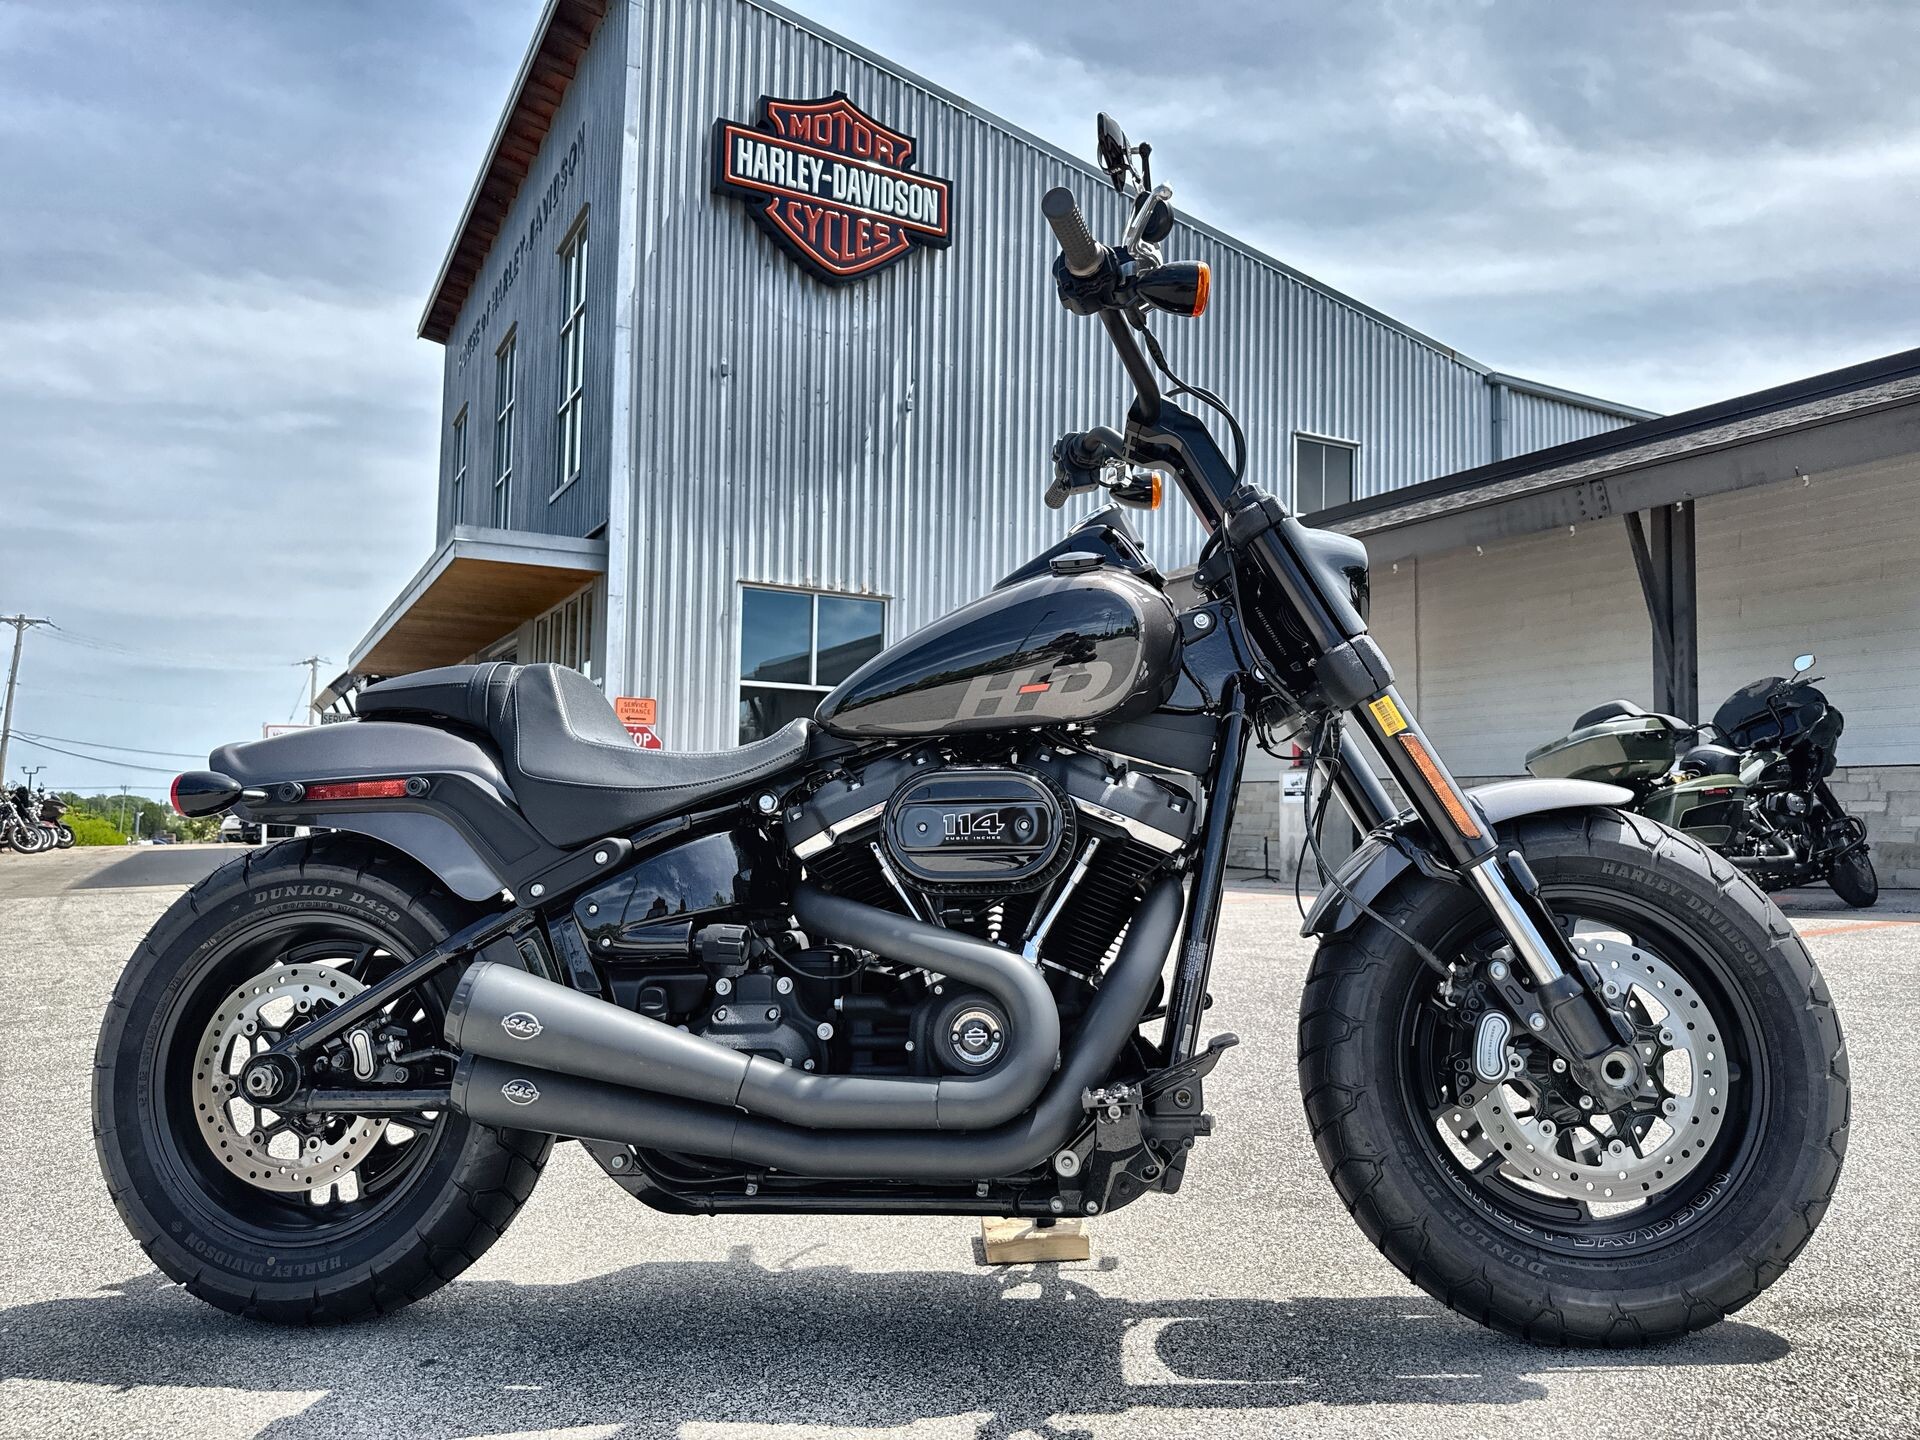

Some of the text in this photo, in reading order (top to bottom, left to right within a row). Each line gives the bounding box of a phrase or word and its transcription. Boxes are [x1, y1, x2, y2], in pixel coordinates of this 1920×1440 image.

[789, 110, 894, 166] MOTOR
[736, 138, 938, 224] HARLEY-DAVIDSON
[491, 121, 587, 316] HARLEY-DAVIDSON
[786, 201, 890, 260] CYCLES
[323, 714, 353, 724] SERVIC
[620, 707, 651, 716] ENTRANCE
[623, 701, 649, 709] SERVICE
[628, 732, 652, 747] OP
[942, 812, 1006, 835] 114
[254, 885, 343, 905] DUNLOP
[350, 892, 401, 923] D429
[1600, 860, 1769, 978] HARLEY-DAVIDSON
[184, 1232, 343, 1278] HARLEY-DAVIDSON
[1444, 1208, 1548, 1277] DUNLOP
